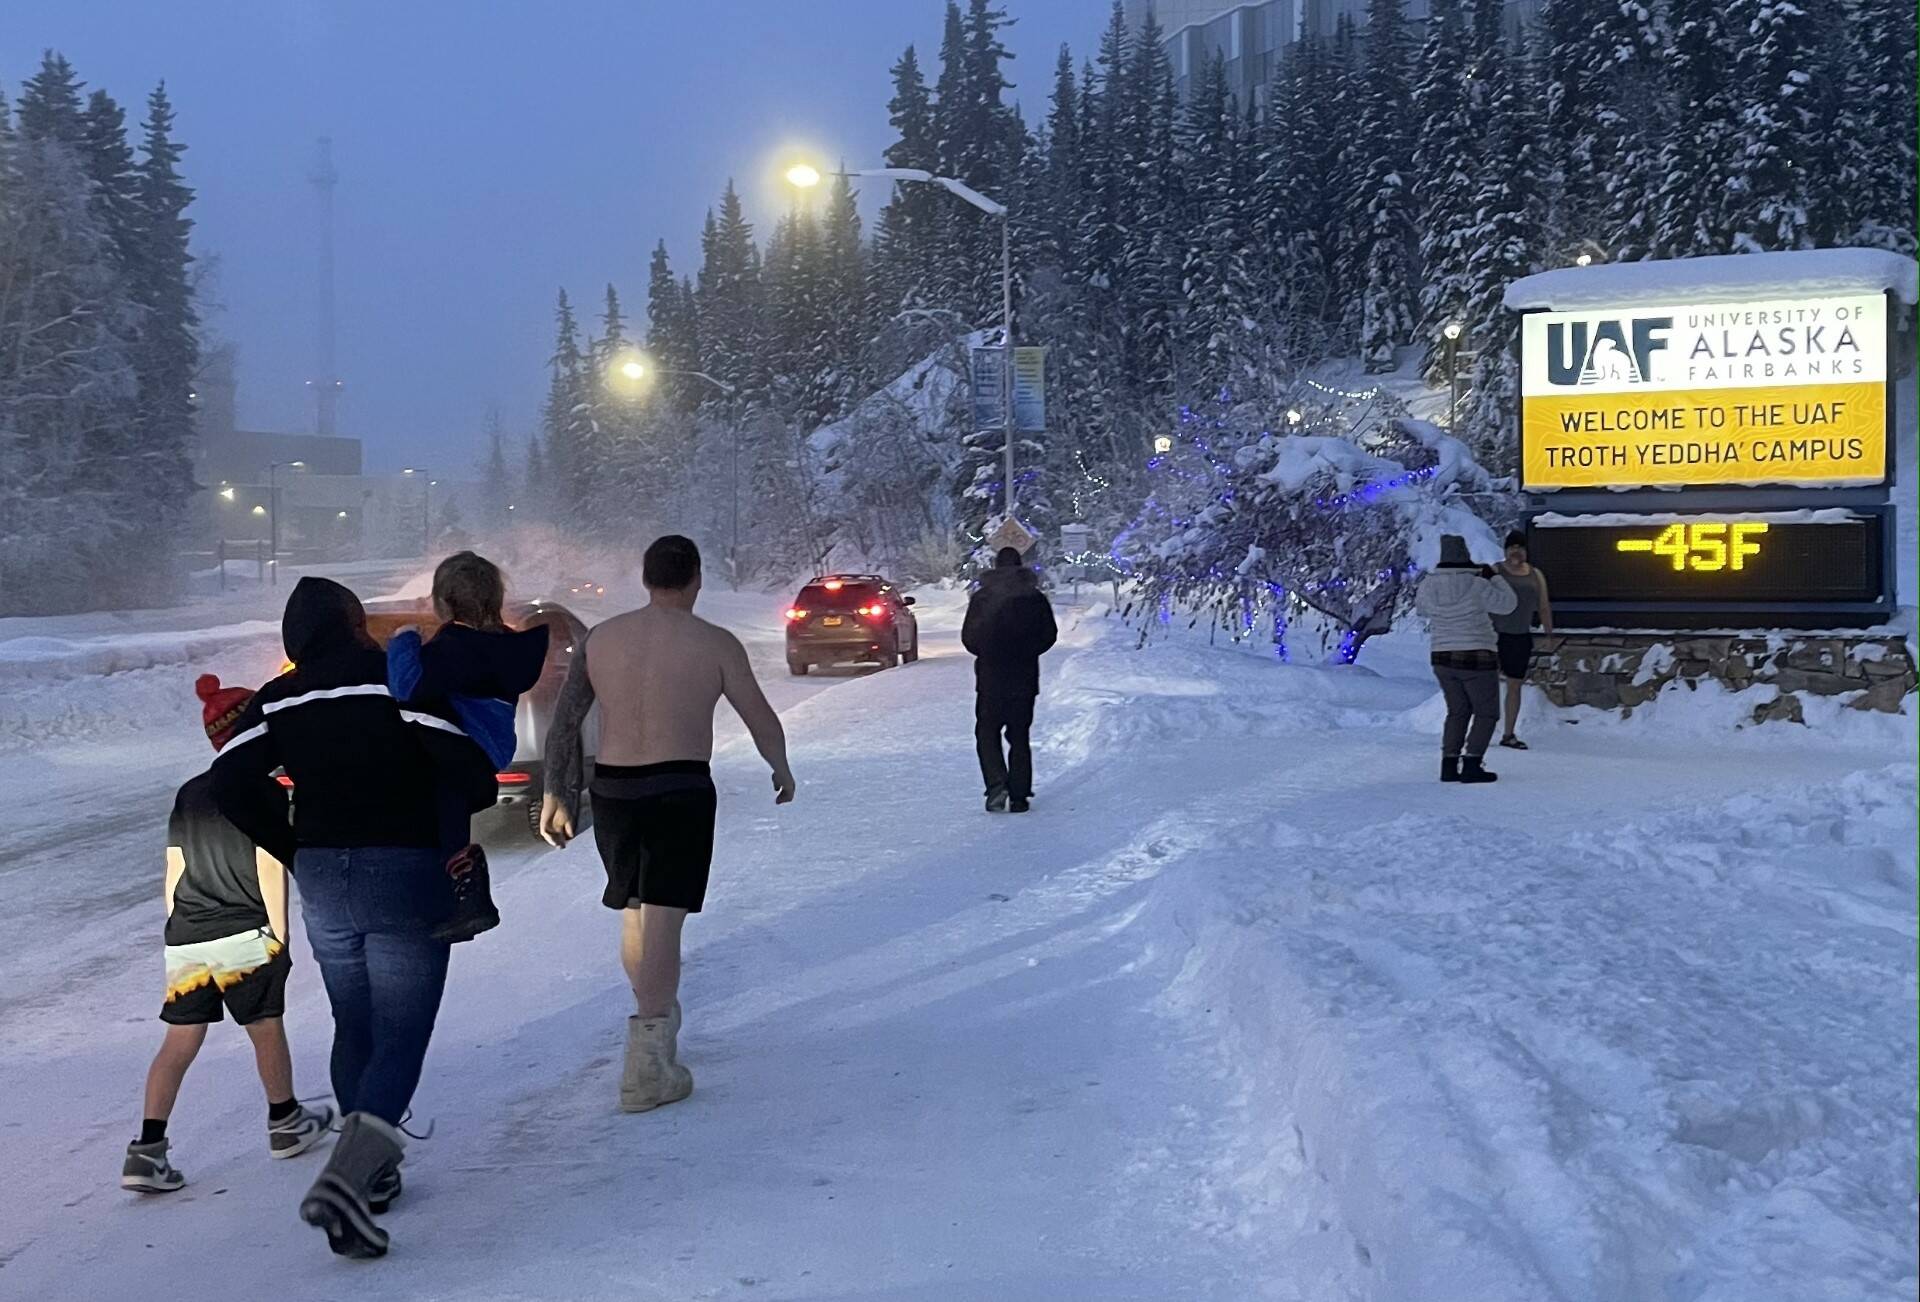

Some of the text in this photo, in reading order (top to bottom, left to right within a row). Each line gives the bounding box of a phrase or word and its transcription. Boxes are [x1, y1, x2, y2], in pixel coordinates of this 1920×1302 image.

[1688, 306, 1863, 328] UNIVERSITY OF
[1548, 317, 1673, 385] UAF
[1688, 325, 1860, 359] ALASKA
[1688, 359, 1863, 380] FAIRBANKS
[1560, 402, 1845, 432] WELCOME TO THE UAF
[1545, 445, 1626, 467] TROTH
[1752, 438, 1863, 462] CAMPUS
[1616, 522, 1769, 571] -45F
